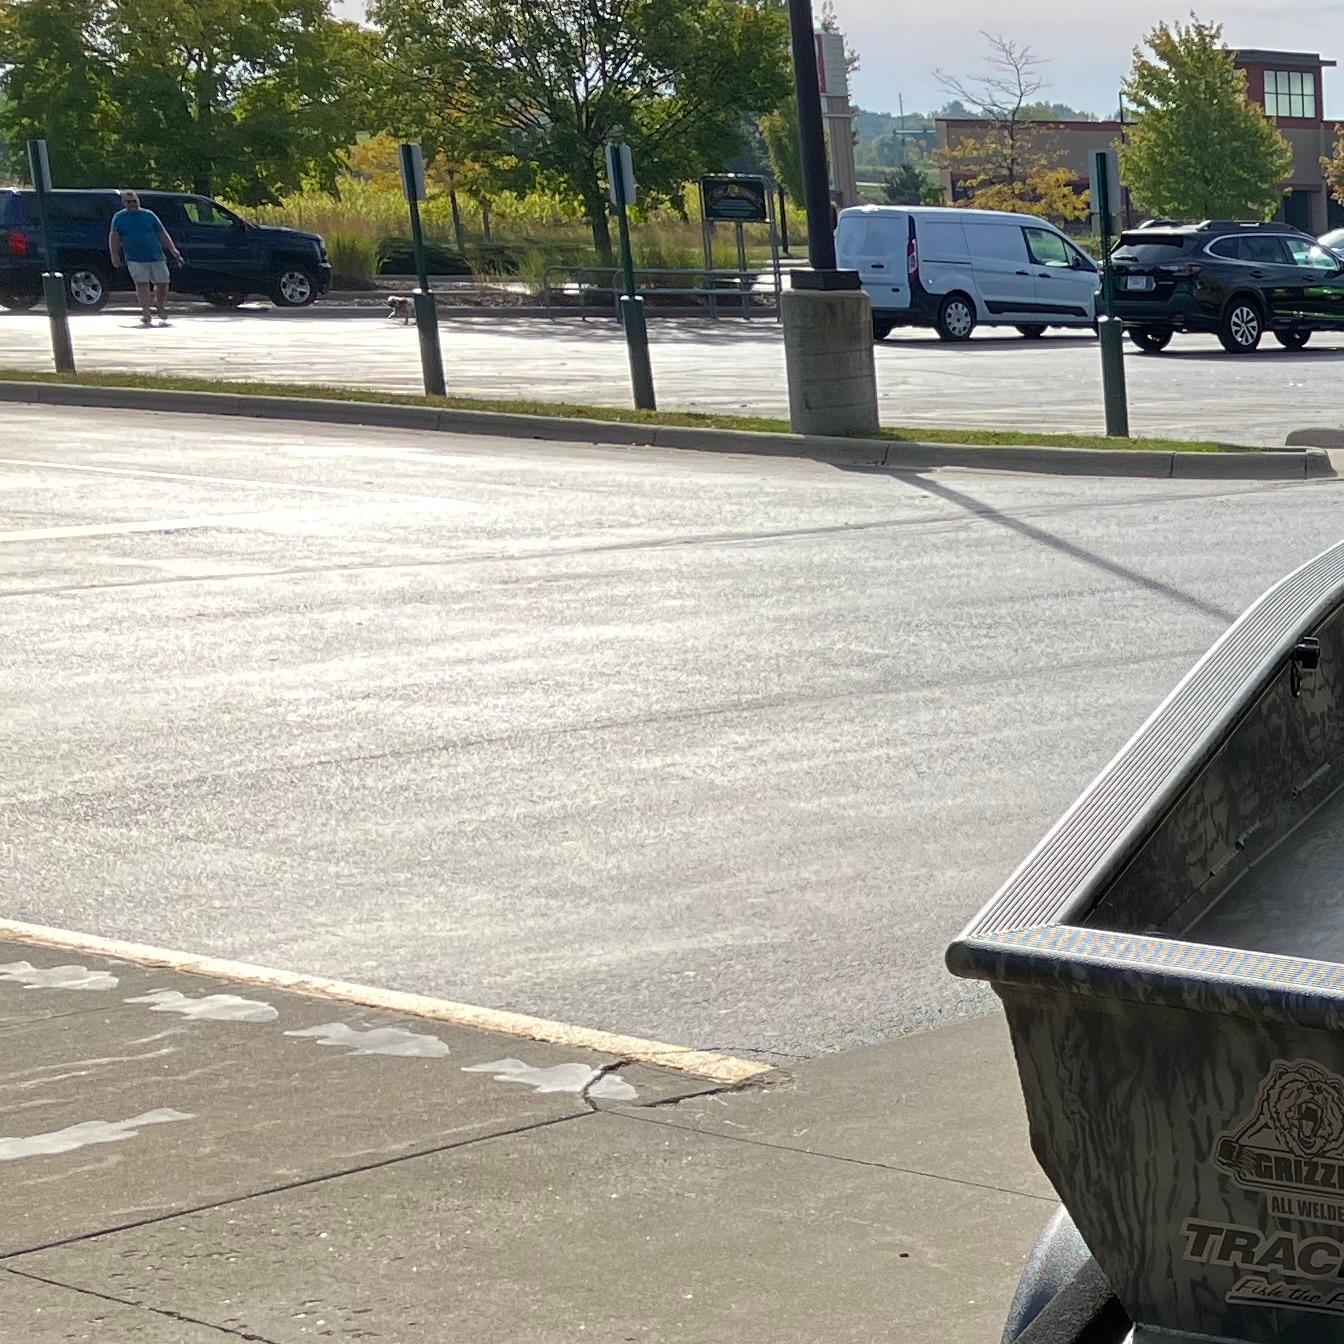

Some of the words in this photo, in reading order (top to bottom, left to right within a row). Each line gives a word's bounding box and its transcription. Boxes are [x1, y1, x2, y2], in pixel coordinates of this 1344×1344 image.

[1271, 1196, 1295, 1216] ALL
[1235, 1277, 1283, 1298] Fish
[1284, 1286, 1322, 1306] the
